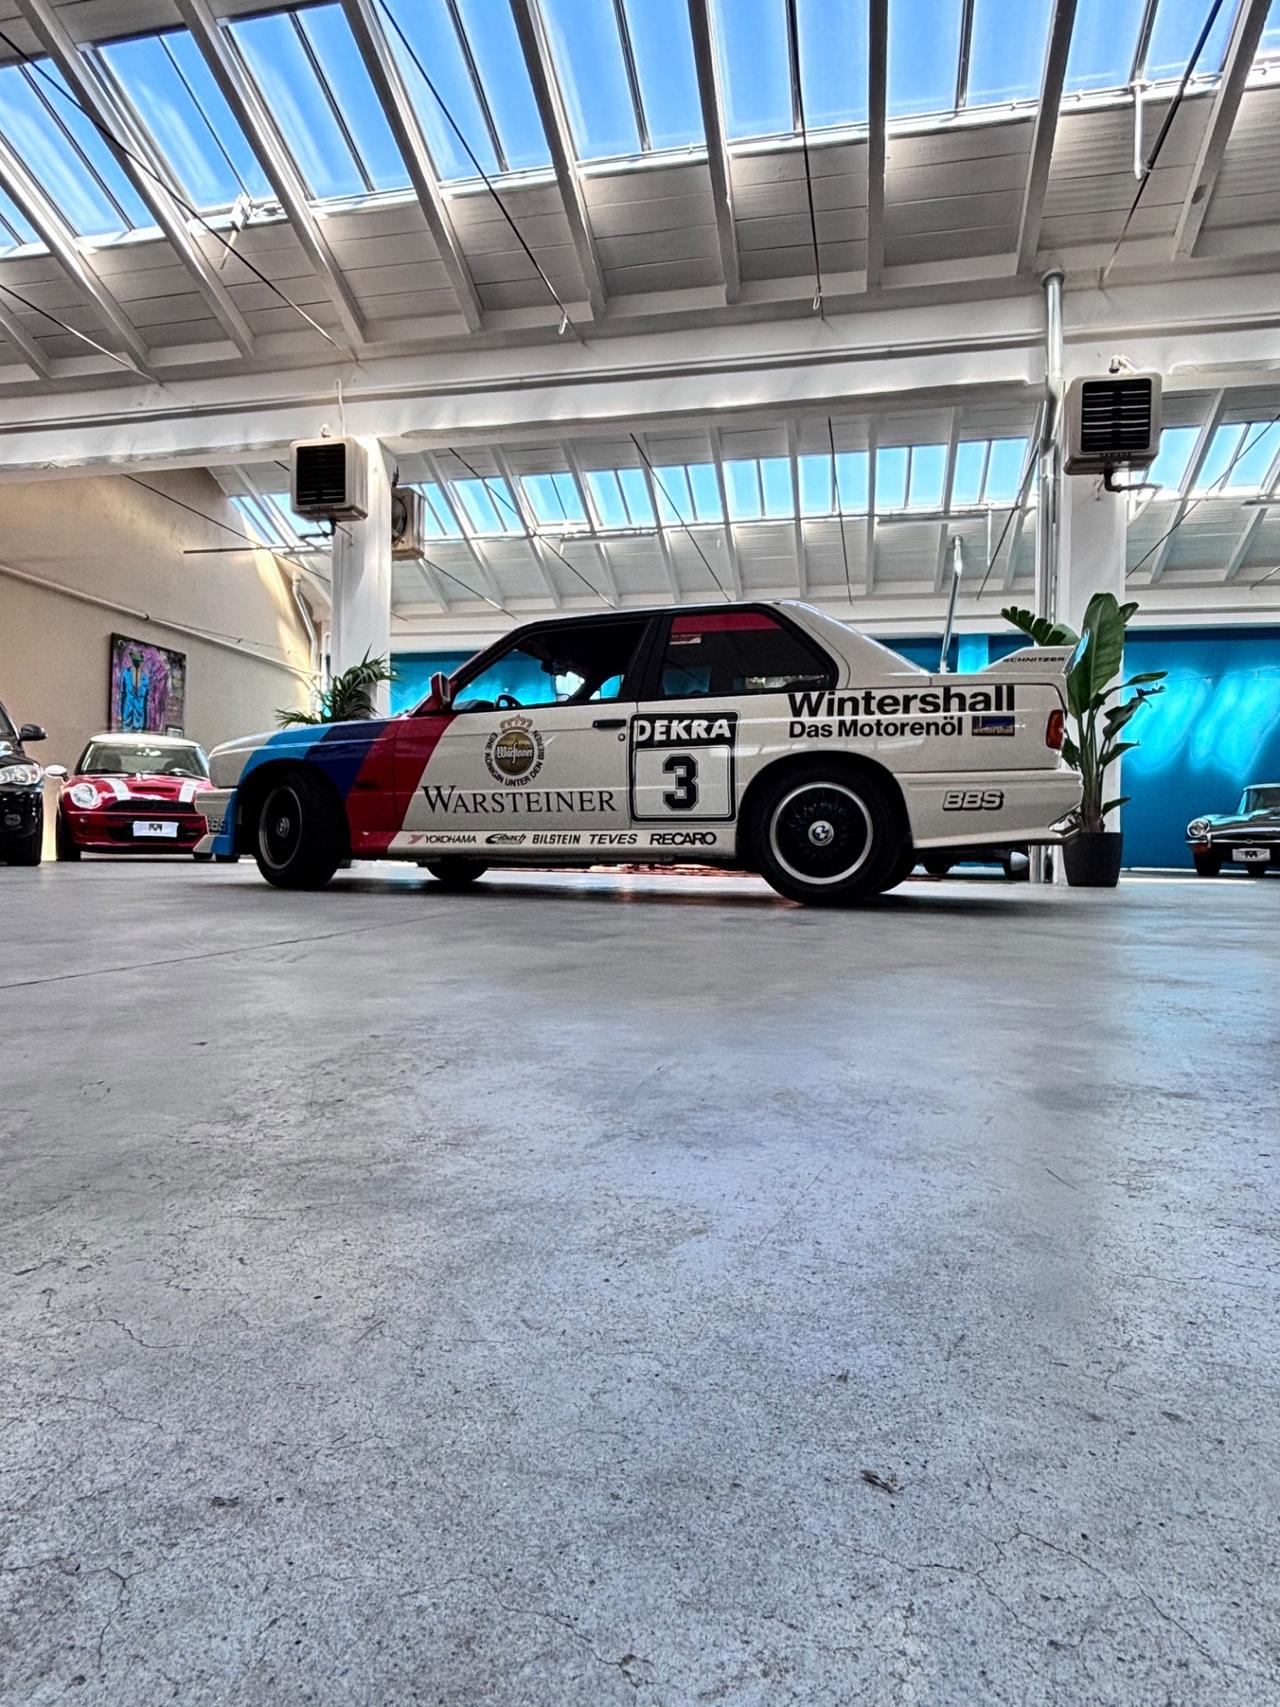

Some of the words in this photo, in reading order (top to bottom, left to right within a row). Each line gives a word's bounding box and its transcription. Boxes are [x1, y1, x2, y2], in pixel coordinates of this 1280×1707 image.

[787, 685, 1015, 718] Wintershall
[633, 719, 731, 742] DEKRA
[789, 720, 833, 738] Das
[838, 716, 963, 738] Motorenöl
[485, 732, 498, 750] EINE
[505, 776, 531, 786] UNTER
[529, 760, 543, 779] DEN
[662, 753, 699, 811] 3
[942, 790, 1005, 811] BBS
[425, 835, 477, 844] YOKOHAMA
[532, 834, 581, 845] BILSTEIN
[589, 834, 638, 845] TEVES
[649, 832, 717, 845] RECARO
